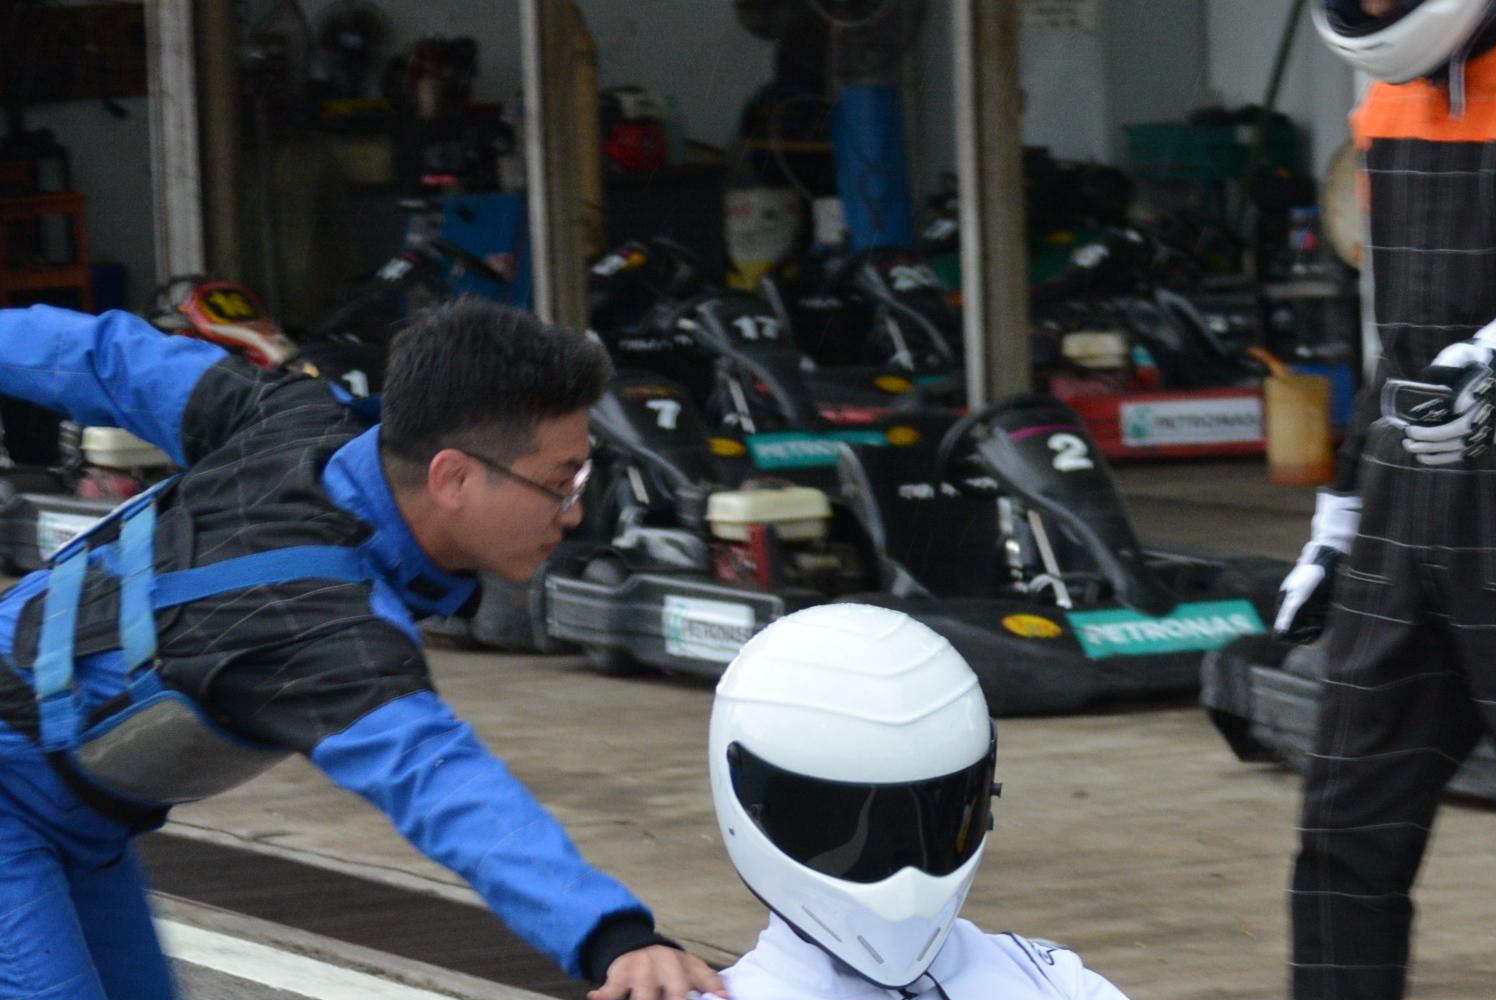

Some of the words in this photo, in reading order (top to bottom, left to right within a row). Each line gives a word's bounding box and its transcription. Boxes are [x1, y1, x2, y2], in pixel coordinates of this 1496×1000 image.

[645, 398, 682, 430] 7
[1047, 432, 1095, 473] 2
[1080, 612, 1257, 647] PETRONAS
